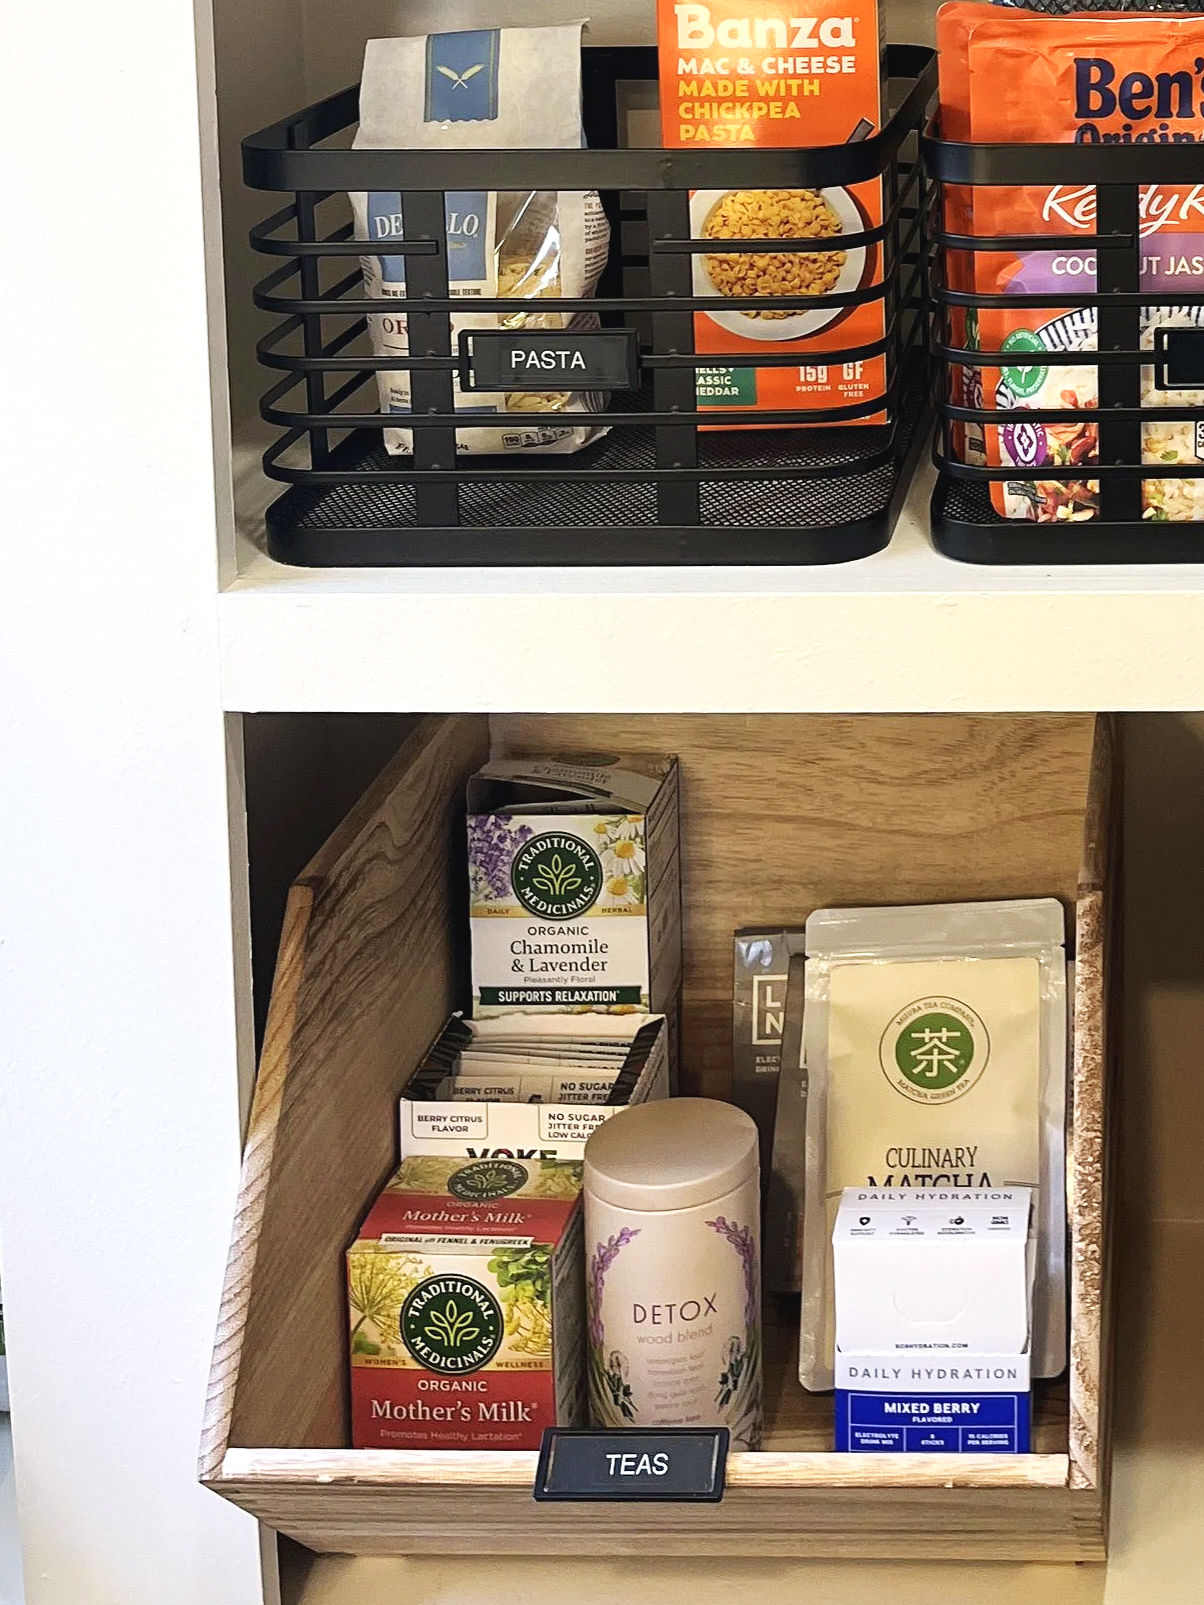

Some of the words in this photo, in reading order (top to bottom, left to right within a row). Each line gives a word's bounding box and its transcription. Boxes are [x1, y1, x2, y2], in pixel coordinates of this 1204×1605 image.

[674, 4, 856, 49] Banza
[677, 57, 730, 75] MAC
[736, 57, 755, 75] &
[761, 56, 856, 74] CHEESE
[678, 79, 749, 97] MADE
[755, 79, 820, 97] WITH
[678, 101, 801, 120] CHICKPEA
[679, 124, 757, 142] PASTA
[511, 350, 587, 369] PASTA
[842, 361, 864, 381] GF
[697, 376, 732, 385] ASSIC
[696, 386, 740, 396] EDDAR
[796, 384, 832, 392] PROTEIN
[838, 383, 869, 391] GLUTEN
[843, 390, 864, 398] FREE
[518, 837, 595, 872] TRADITIONAL
[521, 883, 595, 915] MEDICINALS
[527, 926, 589, 936] ORGANIC
[510, 939, 609, 955] Chamomile
[511, 958, 524, 973] &
[530, 956, 608, 972] Lavender
[498, 991, 552, 1003] SUPPORTS
[555, 990, 617, 1002] RELAXATION
[910, 1027, 961, 1077] 茶
[483, 1086, 515, 1095] CITRUS
[560, 1082, 576, 1091] NO
[417, 1114, 448, 1123] BERRY
[450, 1115, 483, 1123] CITRUS
[548, 1113, 564, 1121] NO
[568, 1113, 606, 1122] SUGAR
[431, 1125, 469, 1133] FLAVOR
[548, 1123, 580, 1131] JITTER
[548, 1131, 568, 1139] LOW
[886, 1146, 978, 1168] CULINARY
[857, 1193, 908, 1201] DAILY
[915, 1193, 1013, 1201] HYDRATION
[446, 1201, 500, 1209] ORGANIC
[402, 1210, 480, 1223] Mother's
[484, 1212, 527, 1225] Milk
[479, 1238, 529, 1246] FENUGREEK
[408, 1281, 495, 1320] TRADITIONAL
[633, 1292, 717, 1325] DETOX
[637, 1331, 673, 1344] wood
[677, 1323, 714, 1343] blend
[411, 1335, 495, 1369] MEDICINALS
[496, 1361, 544, 1369] WELLNESS
[848, 1367, 901, 1379] DAILY
[911, 1368, 1018, 1380] HYDRATION
[417, 1379, 488, 1392] ORGANIC
[370, 1399, 471, 1422] Mother's
[478, 1401, 532, 1422] Milk
[884, 1402, 930, 1414] MIXED
[933, 1402, 981, 1414] BERRY
[912, 1416, 953, 1424] FLAVORED
[380, 1429, 428, 1440] Promotes
[431, 1430, 468, 1441] Healthy
[605, 1453, 669, 1476] TEAS
